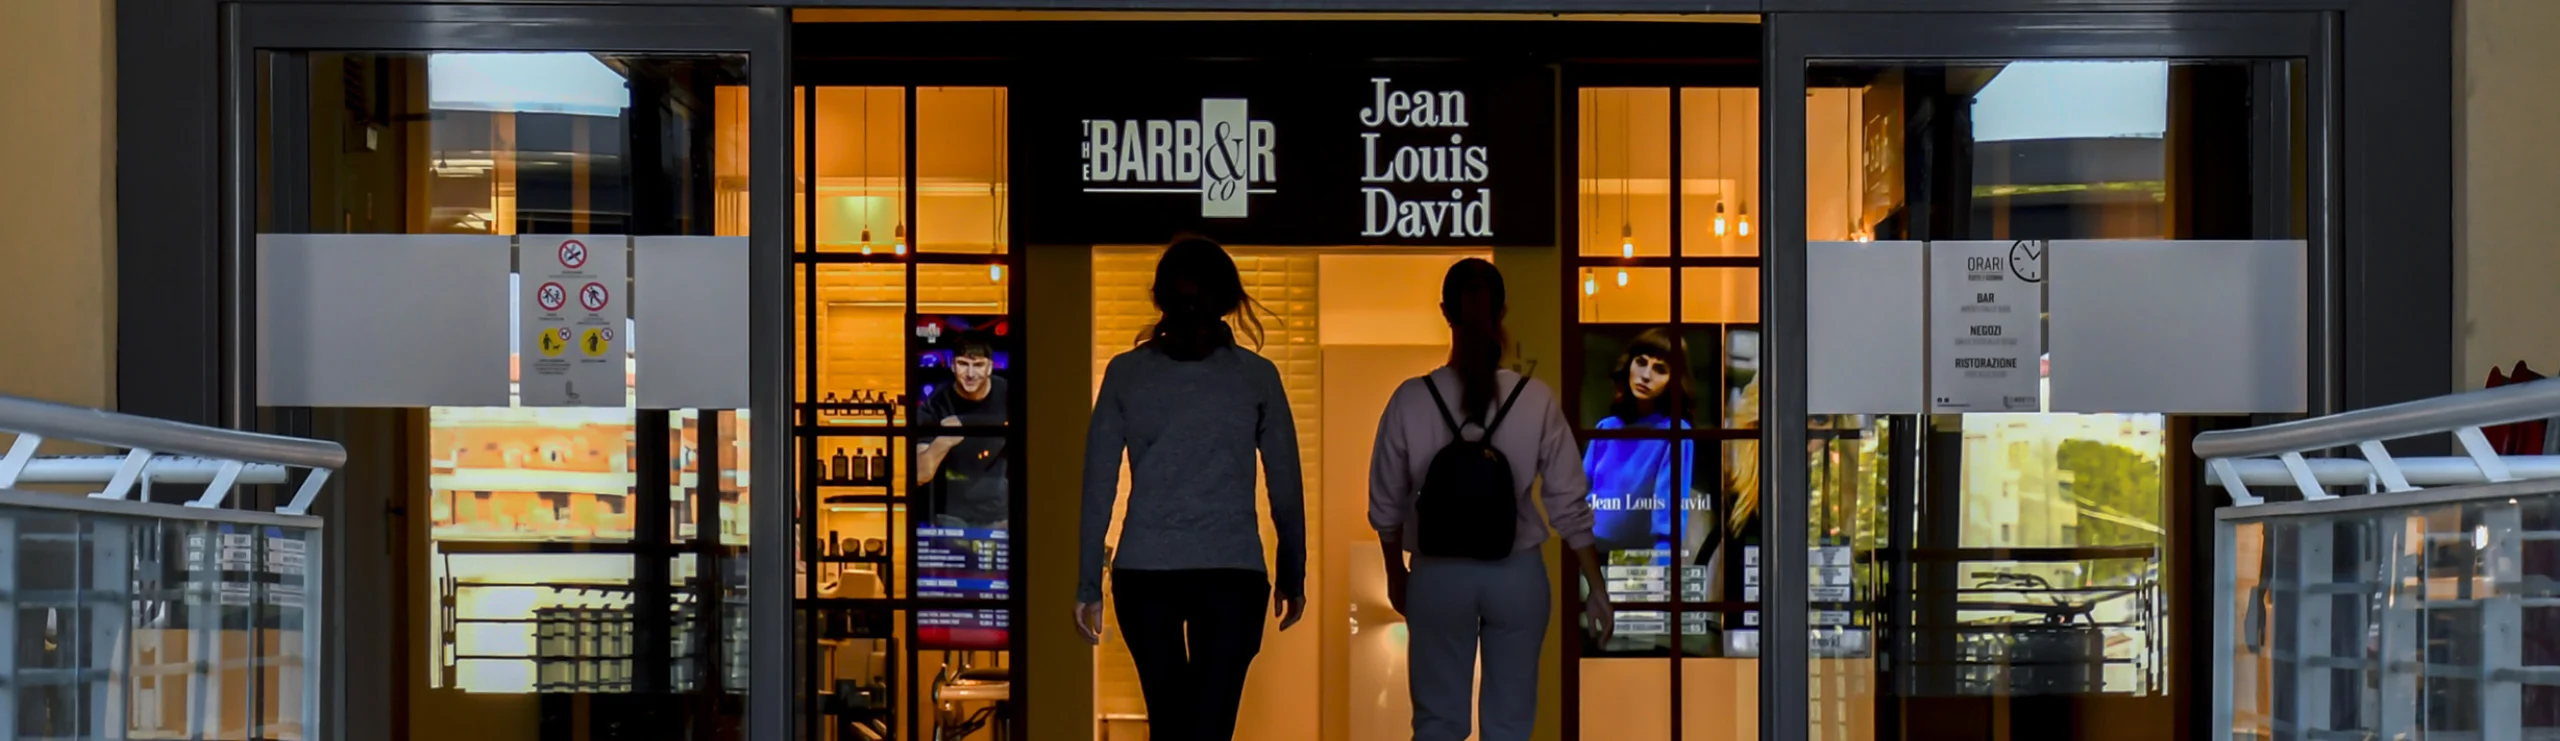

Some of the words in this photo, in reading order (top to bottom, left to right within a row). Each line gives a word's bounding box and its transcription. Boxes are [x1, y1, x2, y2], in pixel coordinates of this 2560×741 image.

[1359, 78, 1469, 126] Jean
[1081, 119, 1091, 181] THE
[1360, 133, 1488, 182] Louis
[1361, 188, 1493, 237] David
[1967, 256, 2004, 271] ORARI
[1976, 293, 1995, 303] BAR
[1970, 325, 2002, 336] NEGOZI
[1955, 358, 2017, 369] RISTORAZIONE
[1588, 494, 1621, 510] Jean
[1626, 494, 1665, 510] Louis
[1681, 494, 1711, 510] avid
